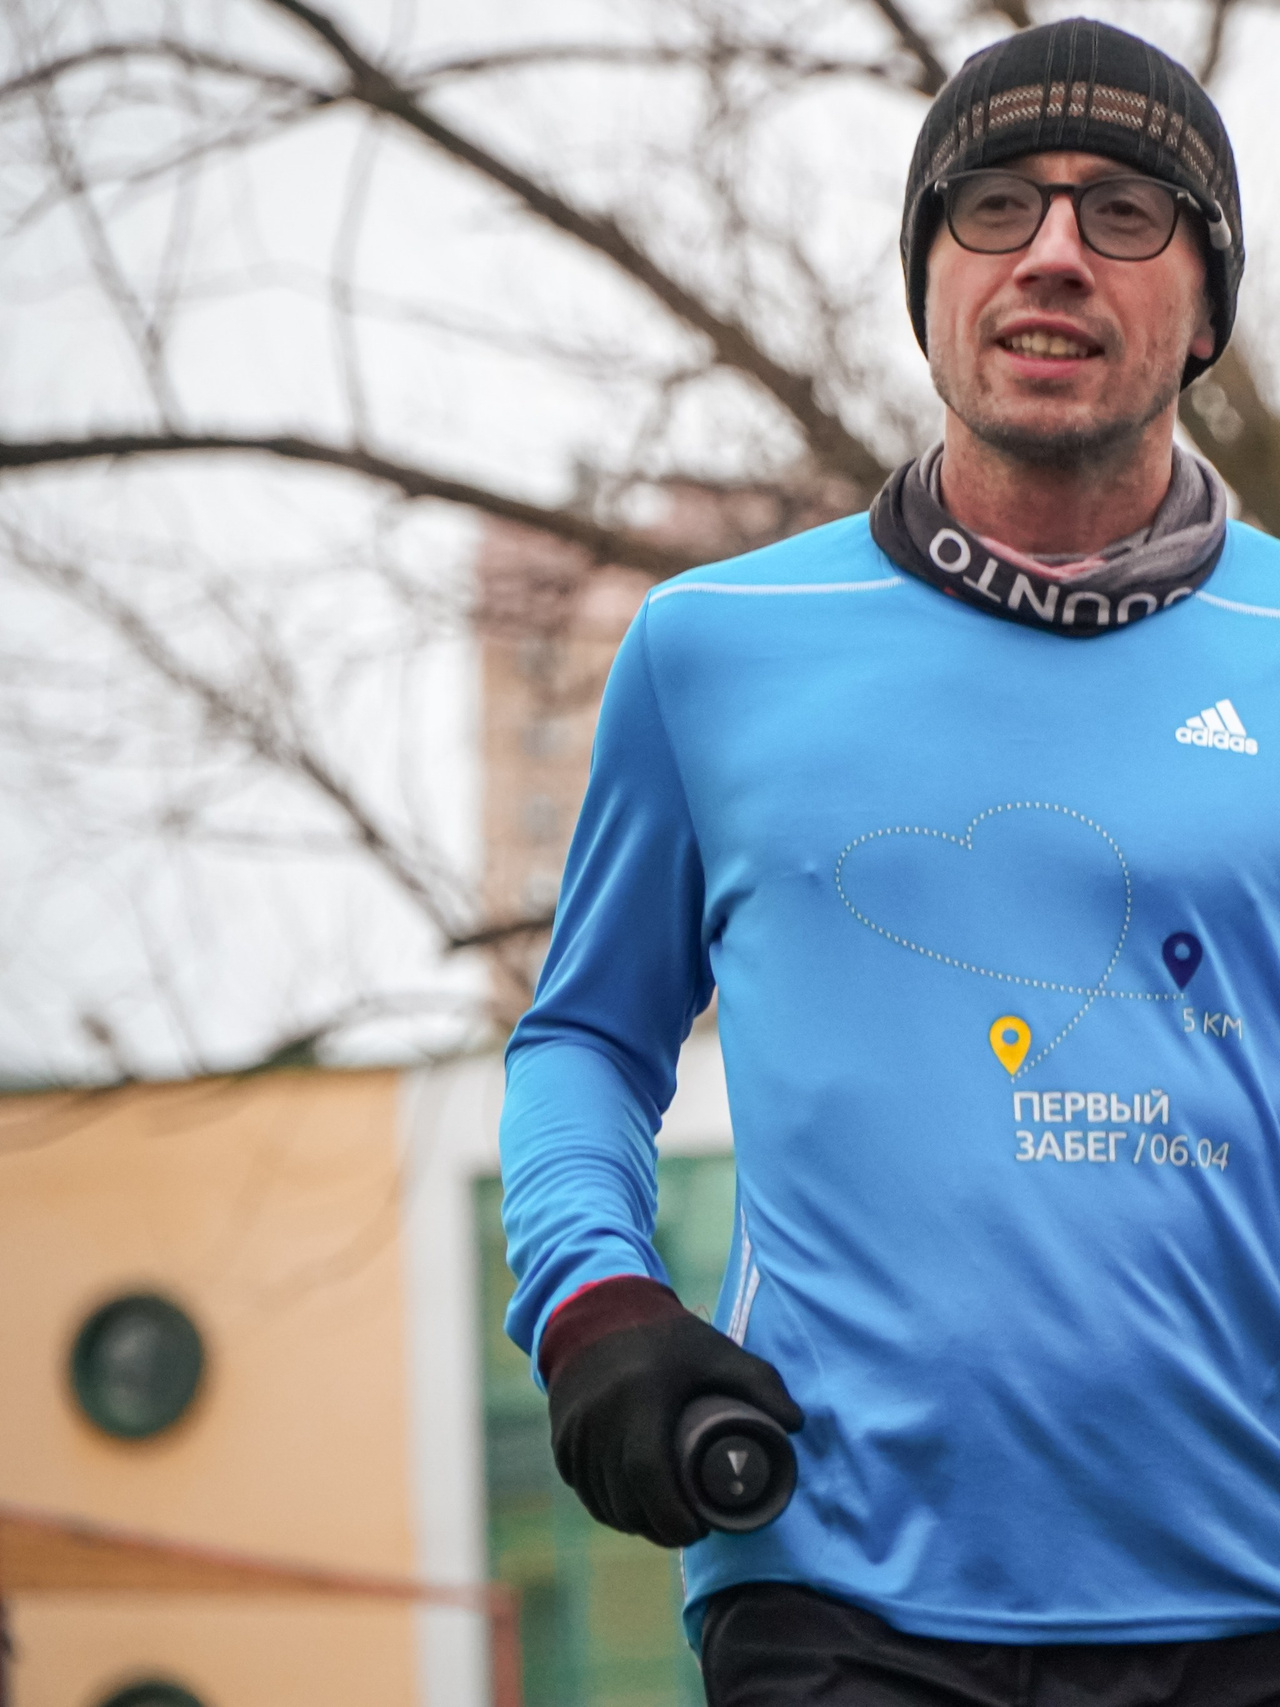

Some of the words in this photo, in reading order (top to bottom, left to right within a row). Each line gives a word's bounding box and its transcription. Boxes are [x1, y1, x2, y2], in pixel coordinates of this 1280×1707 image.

[1174, 726, 1259, 756] adidas
[1182, 1007, 1196, 1033] 5
[1013, 1088, 1170, 1125] ПЕРВЫЙ
[1015, 1130, 1128, 1163] ЗАБЕГ
